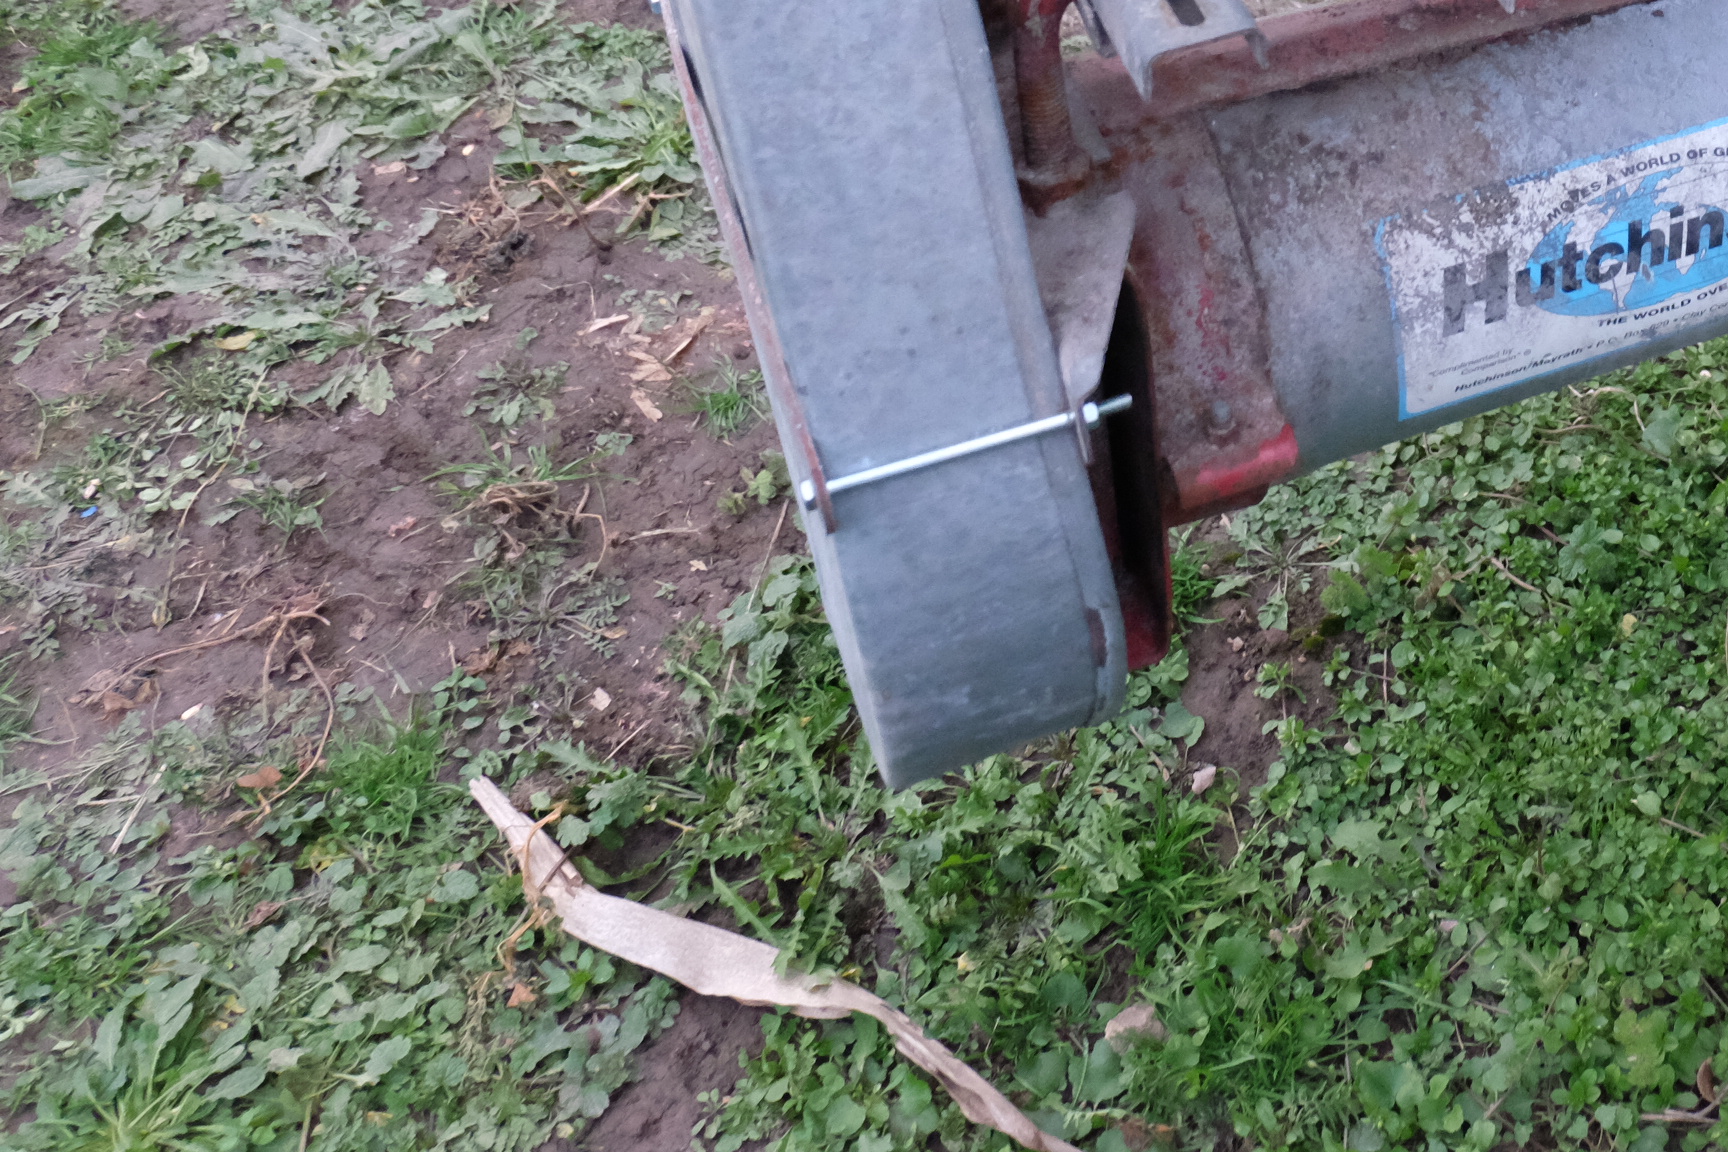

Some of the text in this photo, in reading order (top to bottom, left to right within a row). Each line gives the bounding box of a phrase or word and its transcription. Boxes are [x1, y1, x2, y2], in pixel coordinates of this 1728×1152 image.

[1547, 180, 1602, 224] MOVES
[1607, 173, 1617, 186] A
[1620, 151, 1681, 178] WORLD
[1687, 147, 1708, 161] OF
[1597, 315, 1629, 328] THE
[1634, 298, 1692, 321] WORLD
